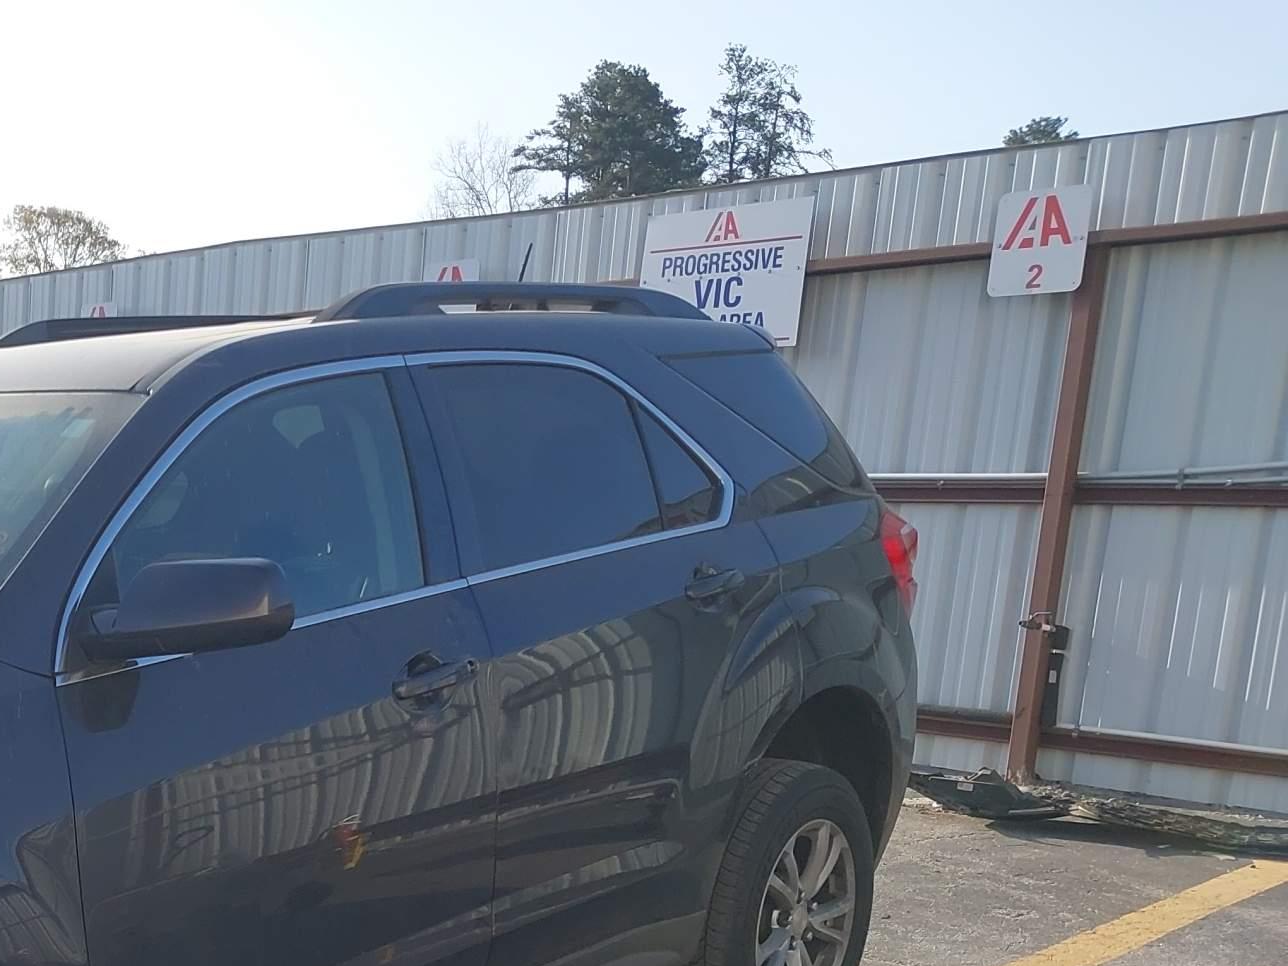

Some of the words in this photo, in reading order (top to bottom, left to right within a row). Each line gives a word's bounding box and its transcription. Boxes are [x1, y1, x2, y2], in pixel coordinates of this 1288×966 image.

[661, 246, 785, 278] PROGRESSIVE
[1025, 264, 1043, 289] 2
[695, 276, 743, 309] VIC
